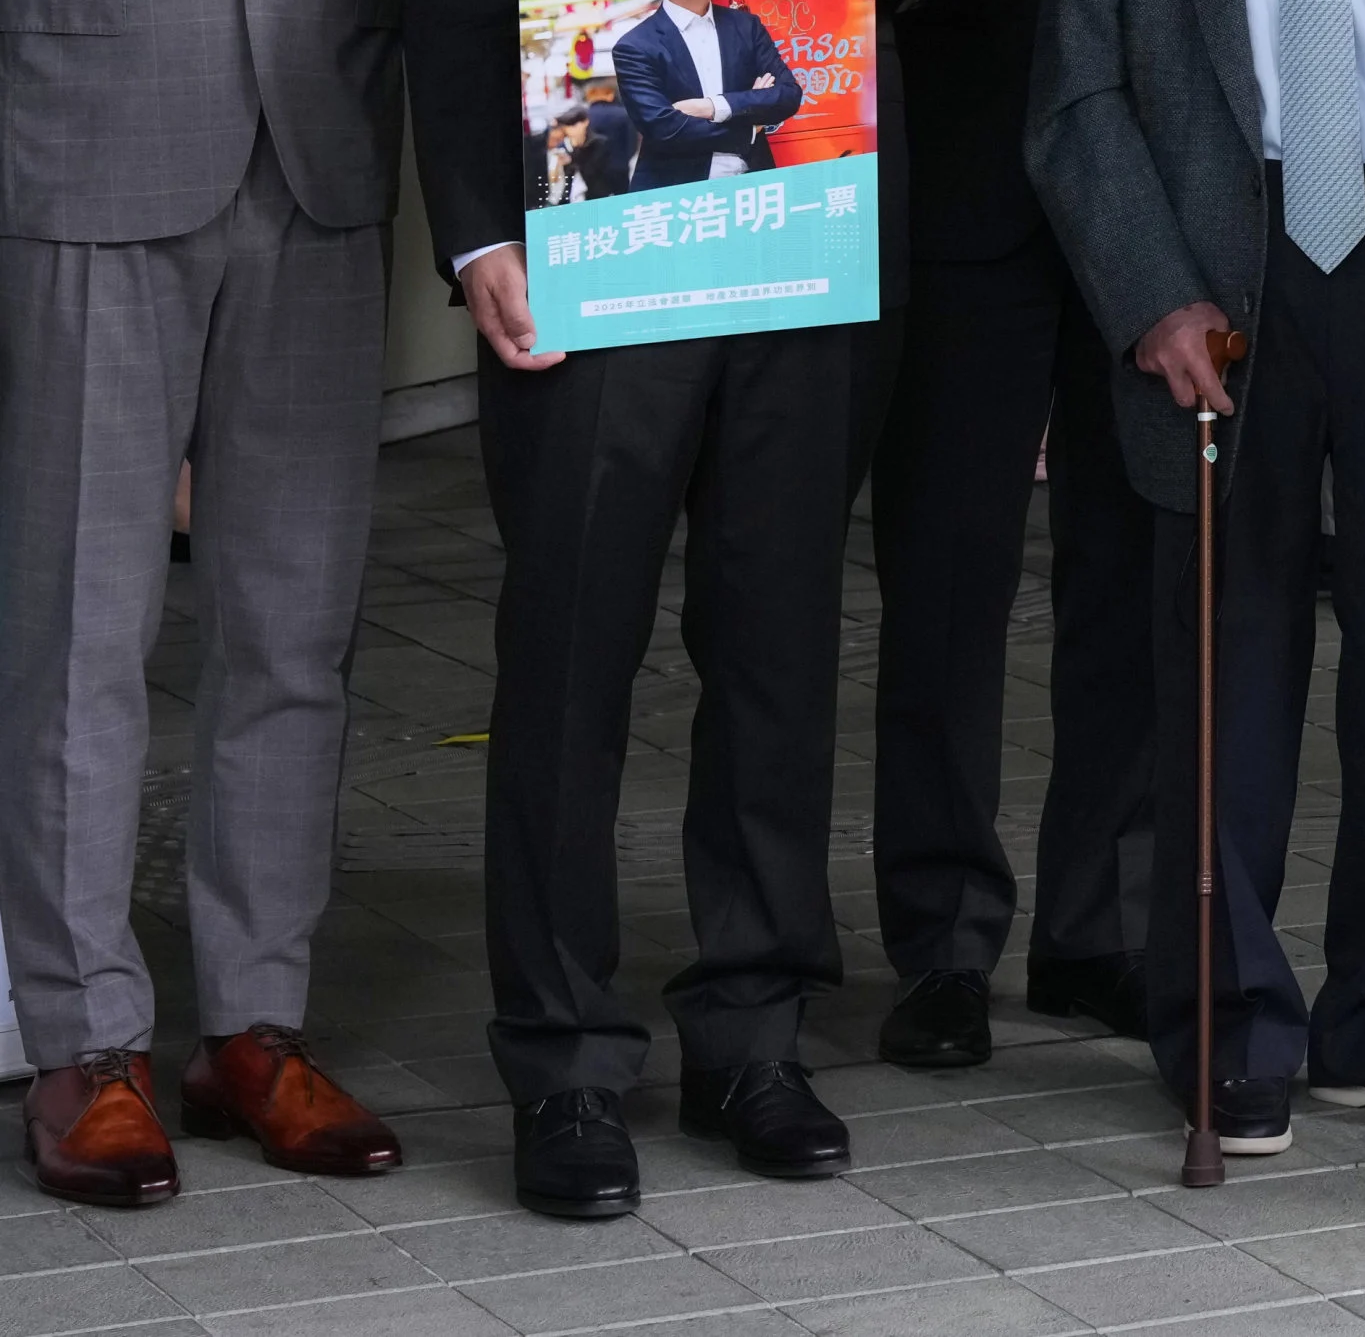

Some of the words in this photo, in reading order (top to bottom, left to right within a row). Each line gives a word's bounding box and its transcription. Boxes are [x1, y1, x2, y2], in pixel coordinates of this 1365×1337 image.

[547, 182, 857, 266] 請投黃浩明一票
